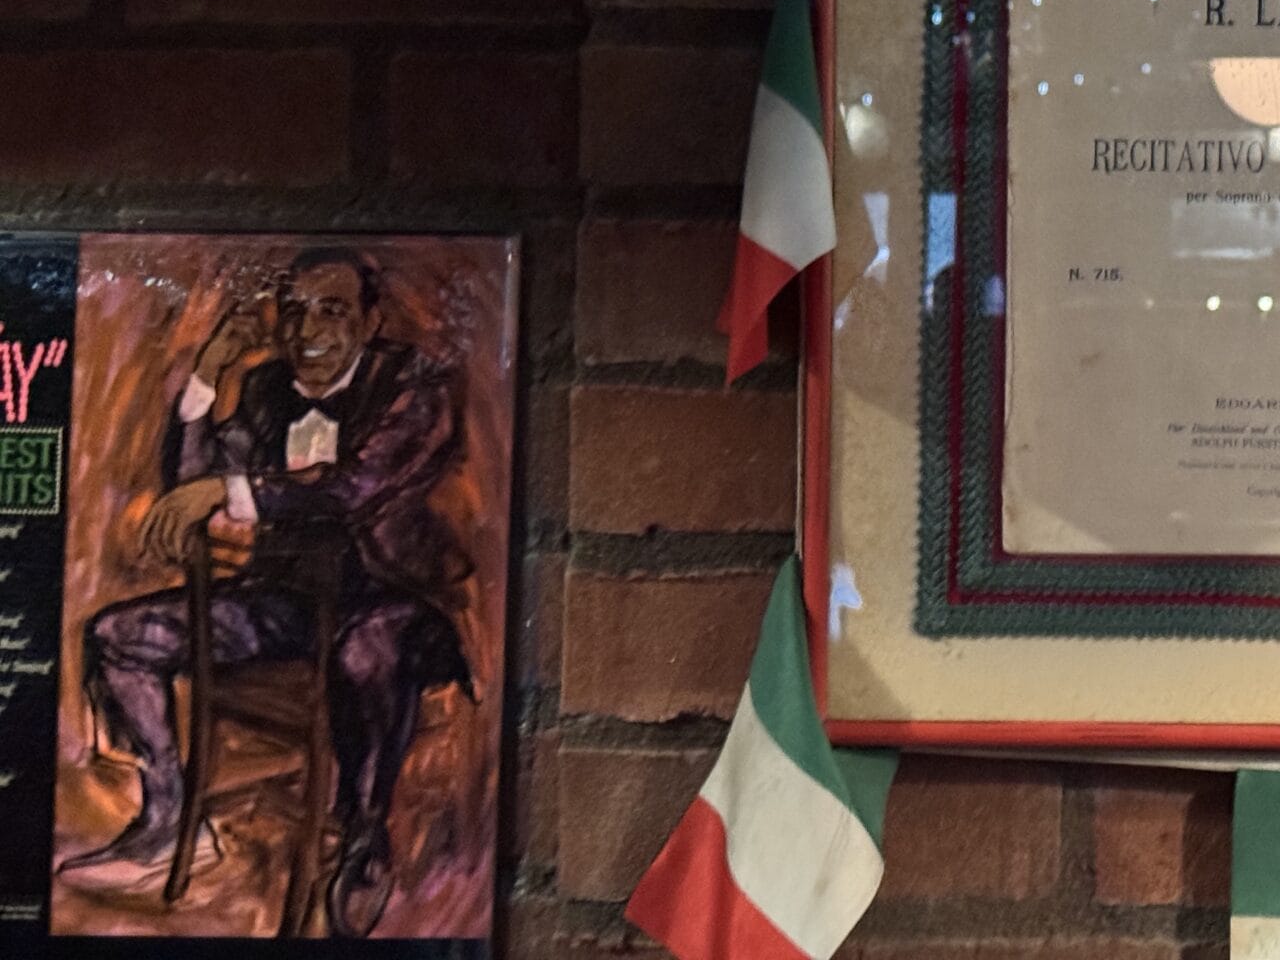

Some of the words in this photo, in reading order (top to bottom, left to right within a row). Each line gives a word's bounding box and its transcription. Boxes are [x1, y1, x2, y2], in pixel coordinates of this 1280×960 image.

[1092, 137, 1266, 174] RECITATIVO
[1186, 191, 1208, 203] per
[1216, 190, 1271, 204] Soprano
[1068, 267, 1085, 281] N.
